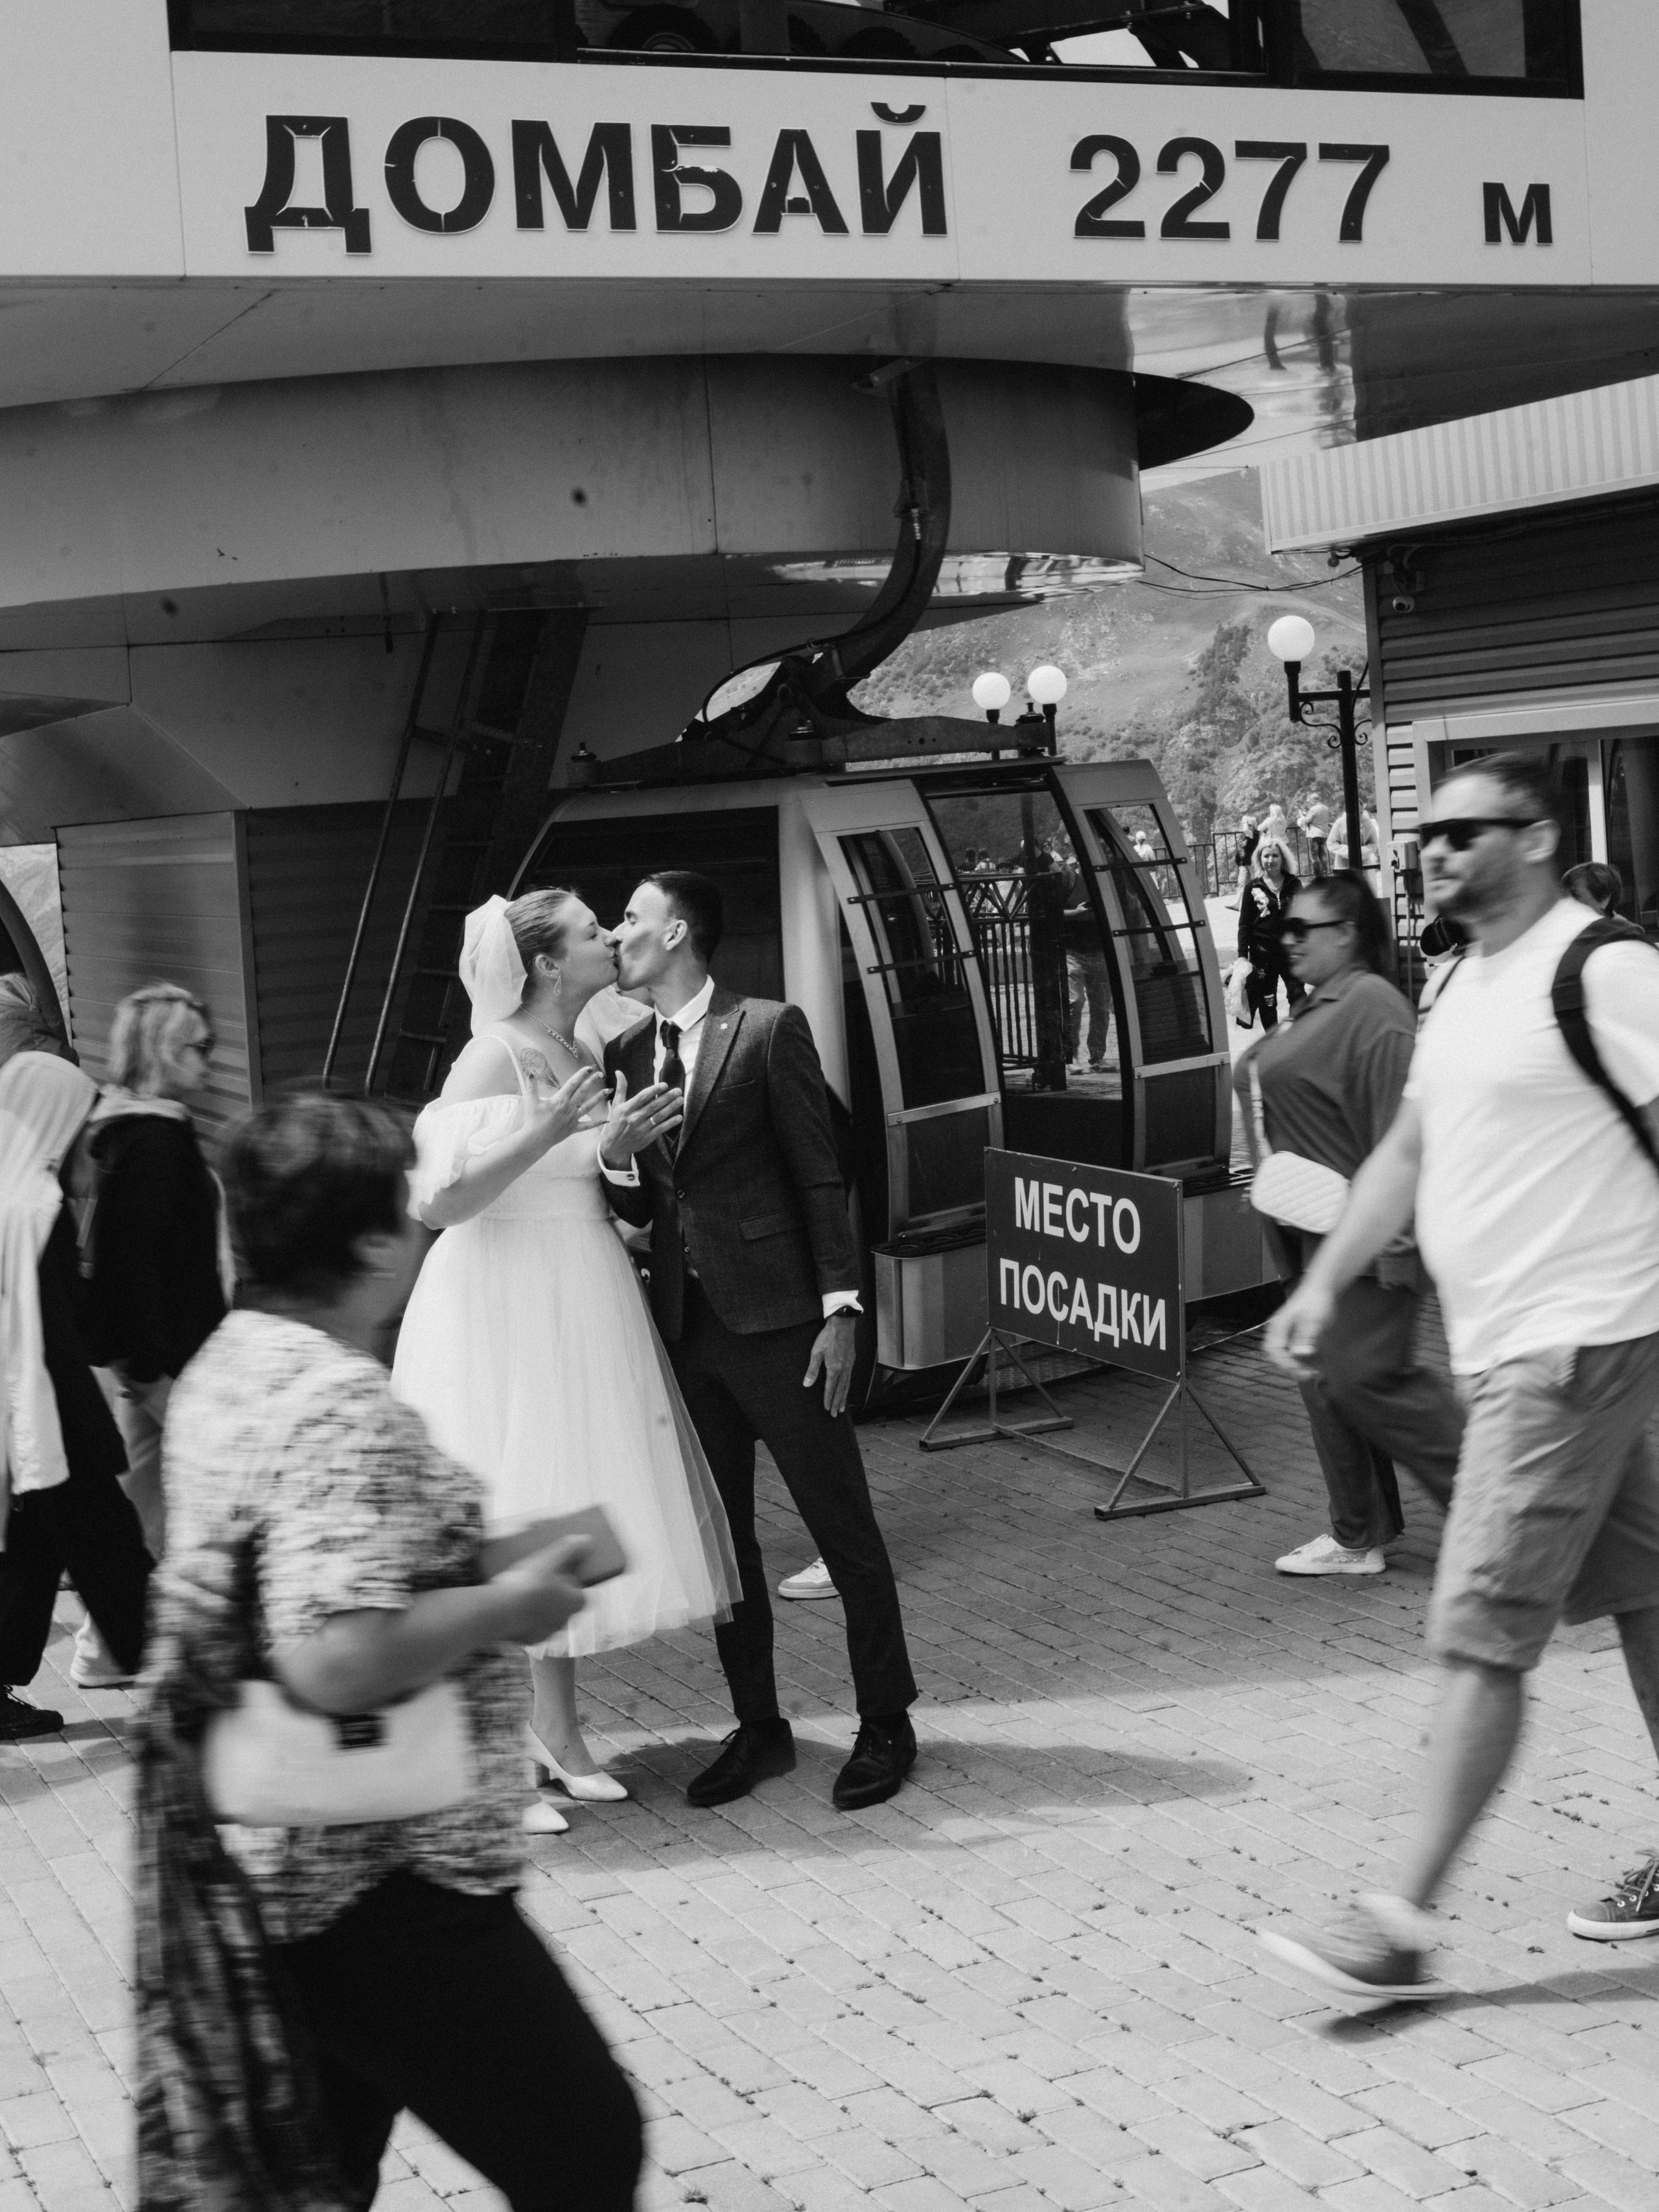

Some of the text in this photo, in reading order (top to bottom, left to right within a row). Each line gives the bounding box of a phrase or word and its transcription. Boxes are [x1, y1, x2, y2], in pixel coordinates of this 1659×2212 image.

[245, 102, 948, 253] ДОМБАЙ
[1069, 134, 1391, 244] 2277
[1014, 1176, 1141, 1254] МЕСТО
[999, 1257, 1166, 1351] ПОСАДКИ
